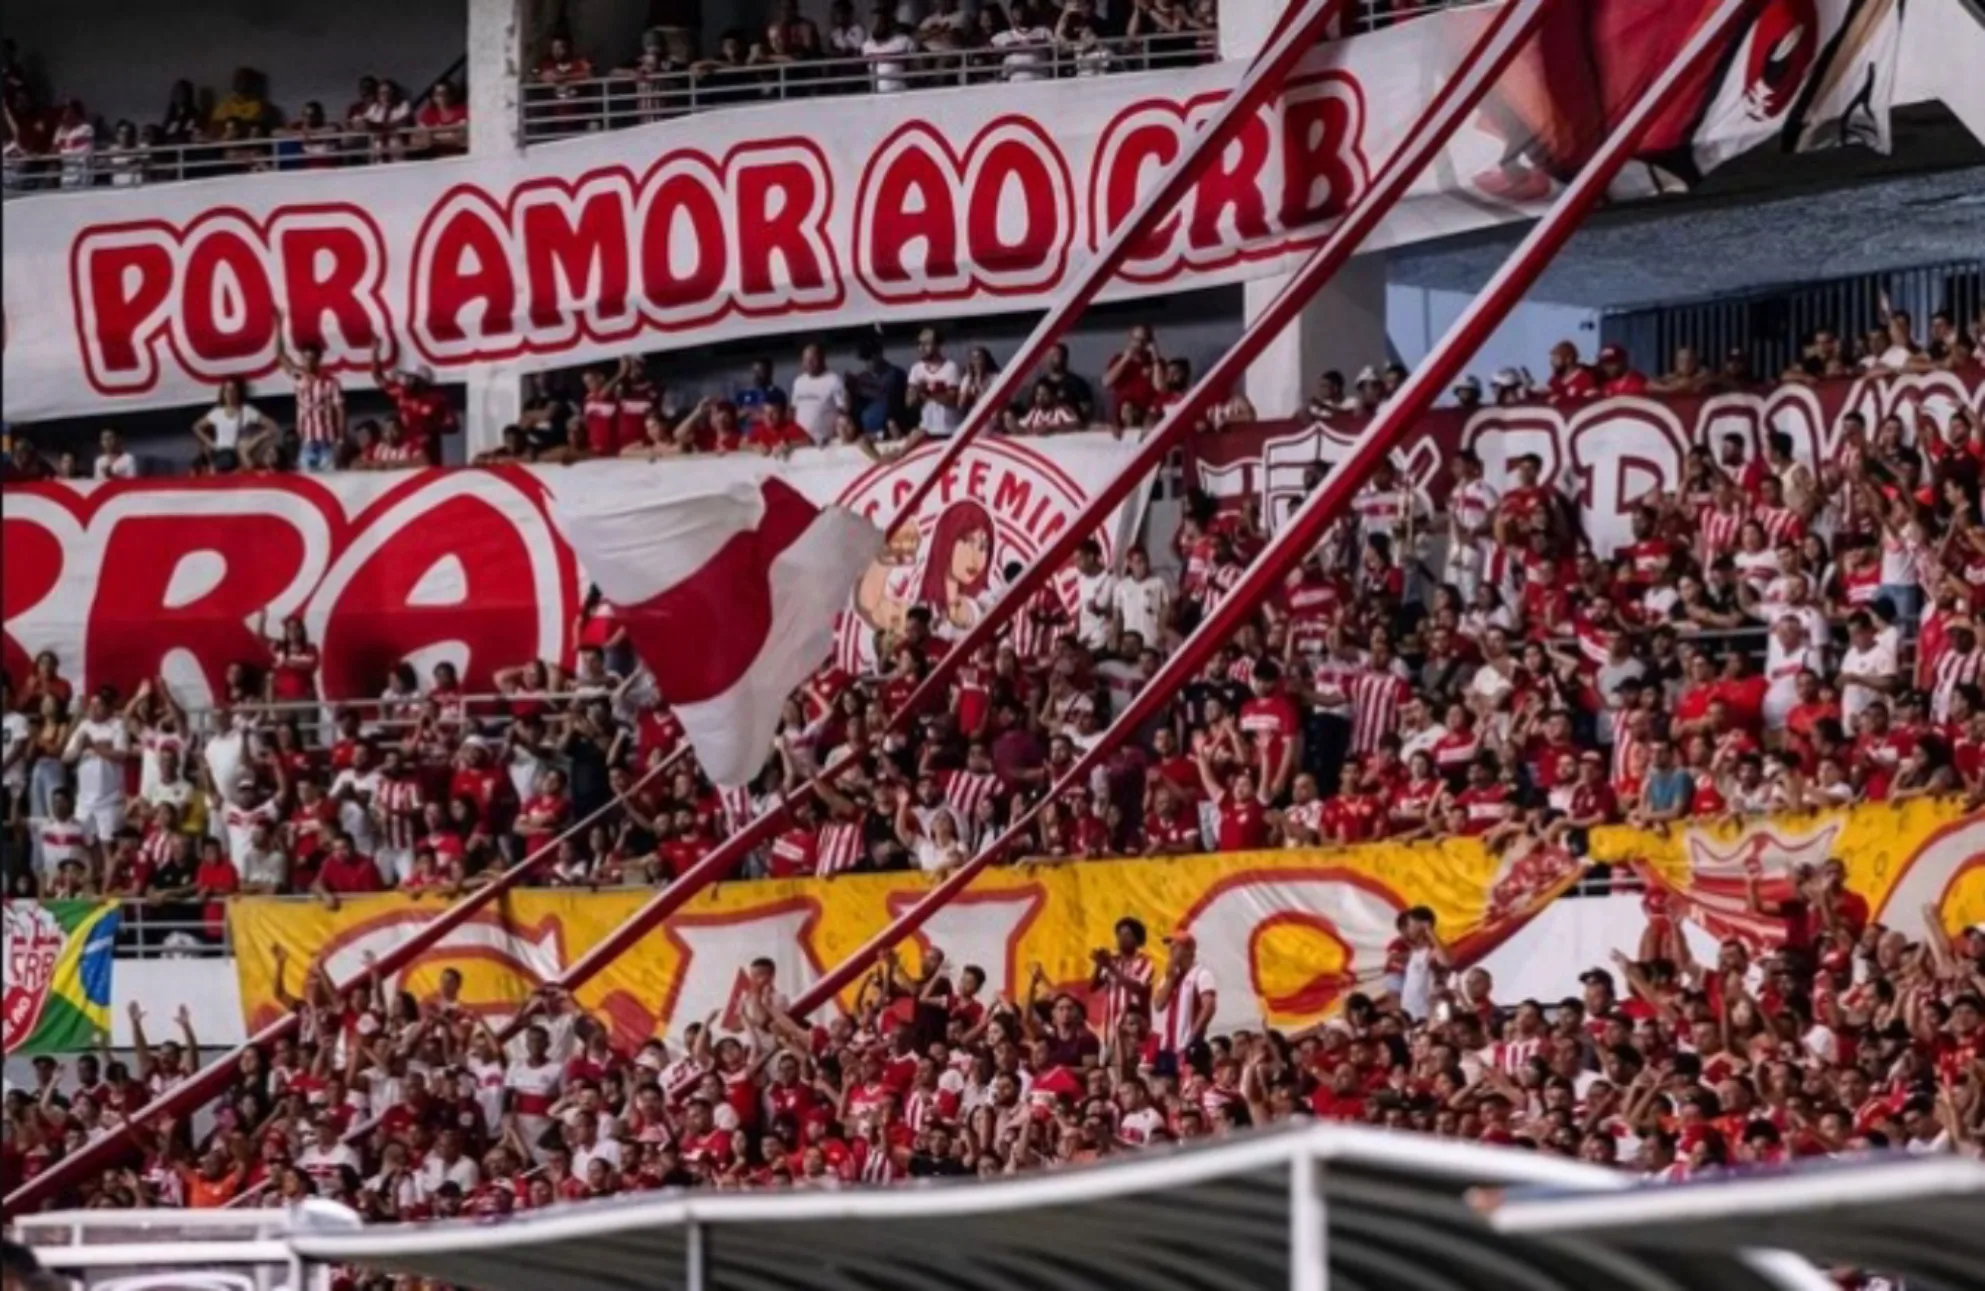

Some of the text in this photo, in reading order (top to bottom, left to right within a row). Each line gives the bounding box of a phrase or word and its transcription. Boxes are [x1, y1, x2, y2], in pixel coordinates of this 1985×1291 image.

[71, 69, 1370, 394] POR AMOR AO CRB
